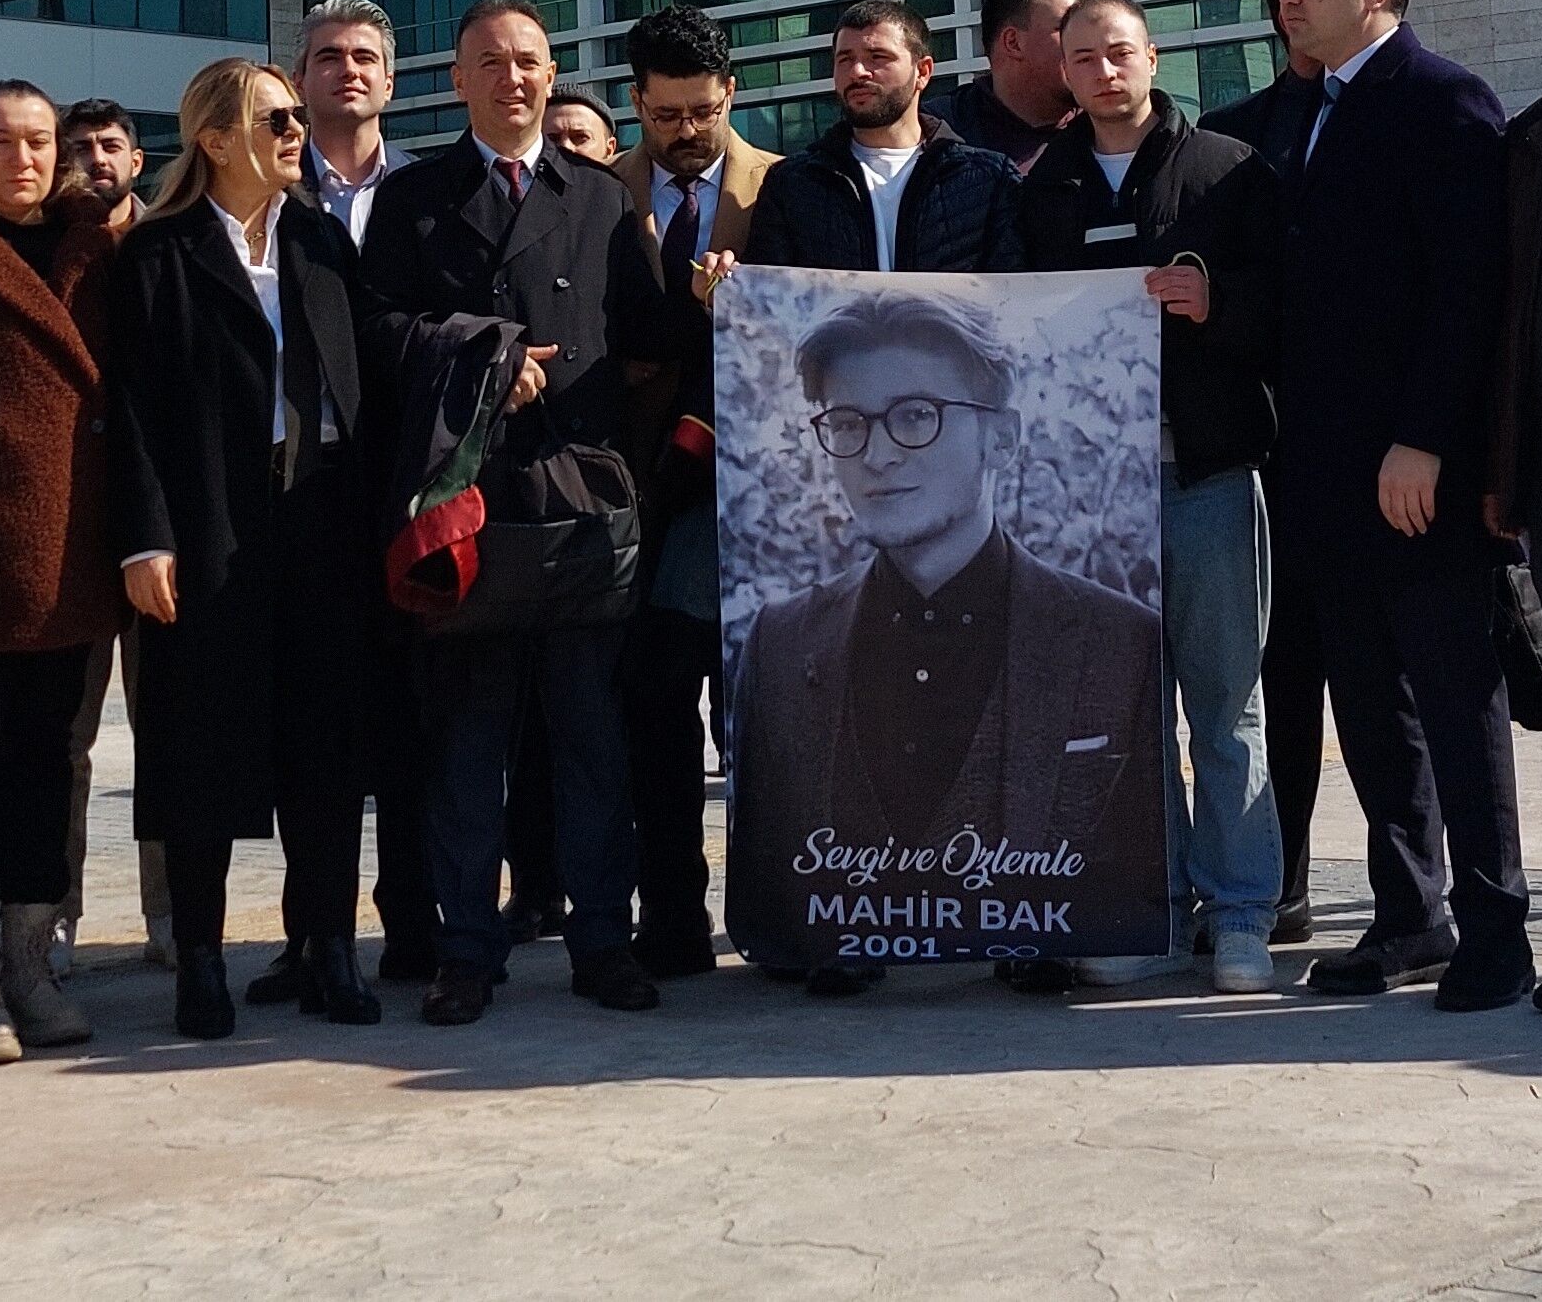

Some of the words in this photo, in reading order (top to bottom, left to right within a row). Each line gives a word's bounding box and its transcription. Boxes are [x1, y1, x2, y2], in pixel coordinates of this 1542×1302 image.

[793, 828, 895, 886] Sevgi
[898, 847, 938, 873] ve
[942, 824, 1086, 890] Özlemle
[807, 891, 964, 929] MAHİR
[980, 900, 1073, 933] BAK
[838, 935, 941, 959] 2001
